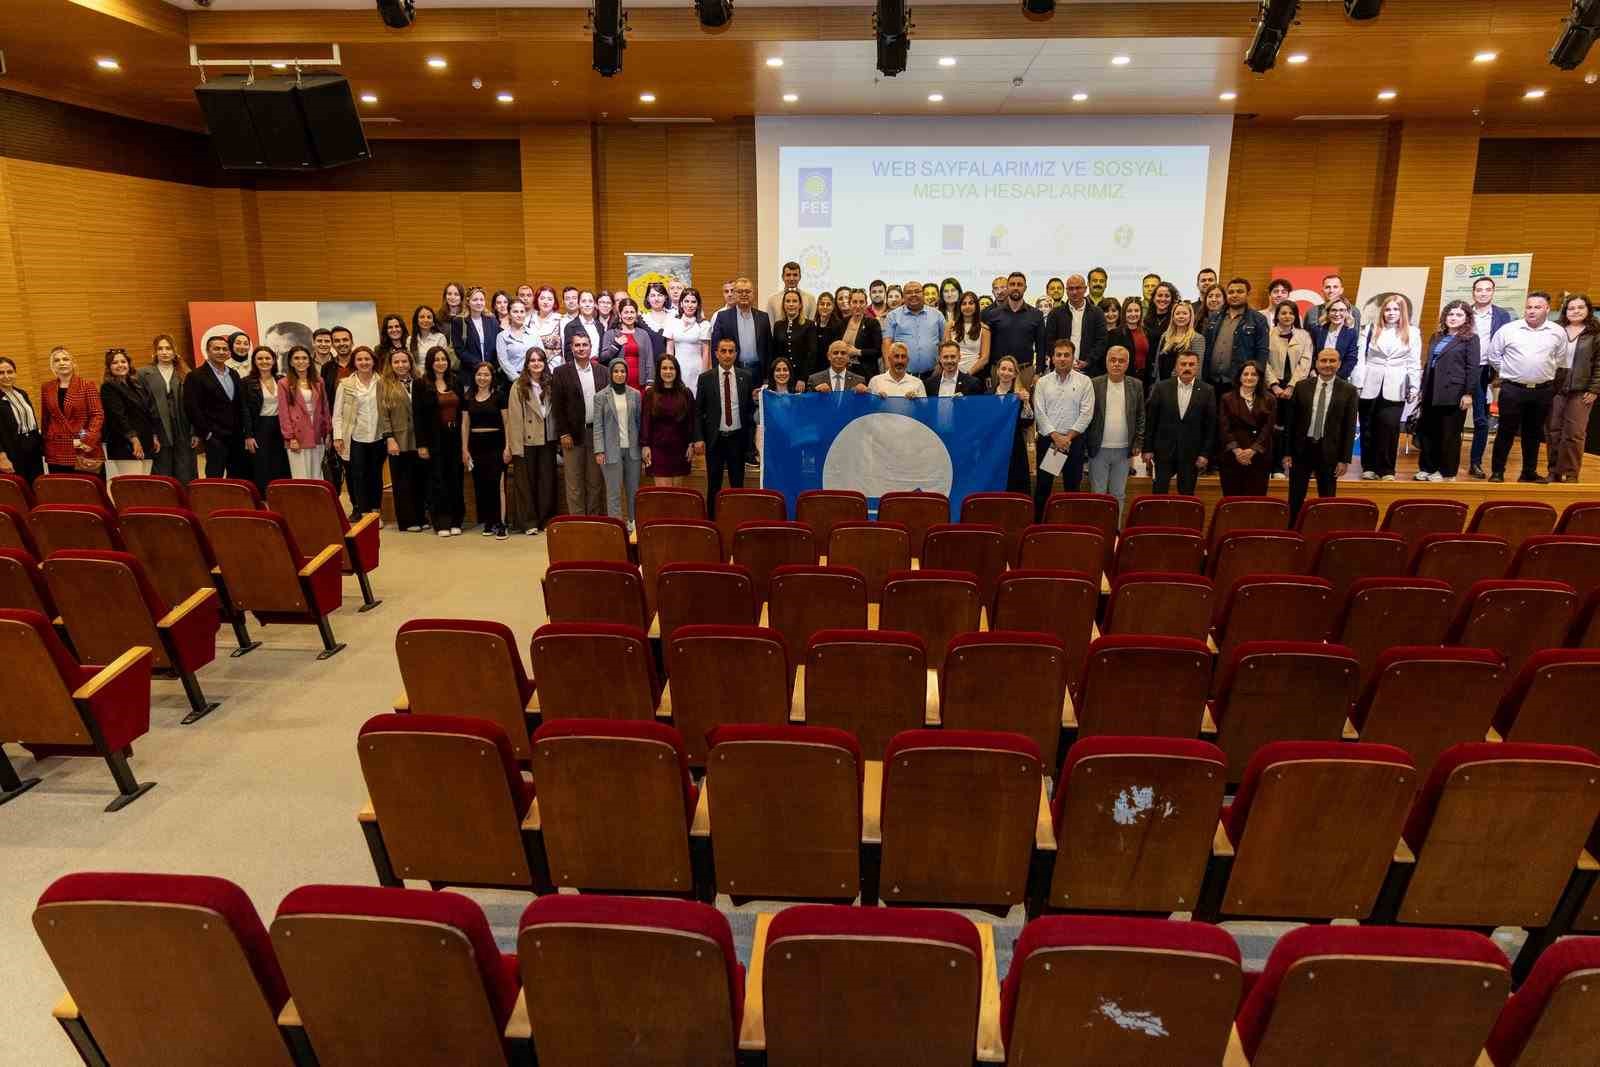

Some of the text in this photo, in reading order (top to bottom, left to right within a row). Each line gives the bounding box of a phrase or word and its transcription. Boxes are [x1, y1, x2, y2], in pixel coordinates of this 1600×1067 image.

[872, 160, 1169, 177] WEB SAYFALARIMIZ VE SOSYAL
[912, 183, 1125, 200] MEDYA HESAPLARIMIZ
[801, 200, 830, 214] FEE
